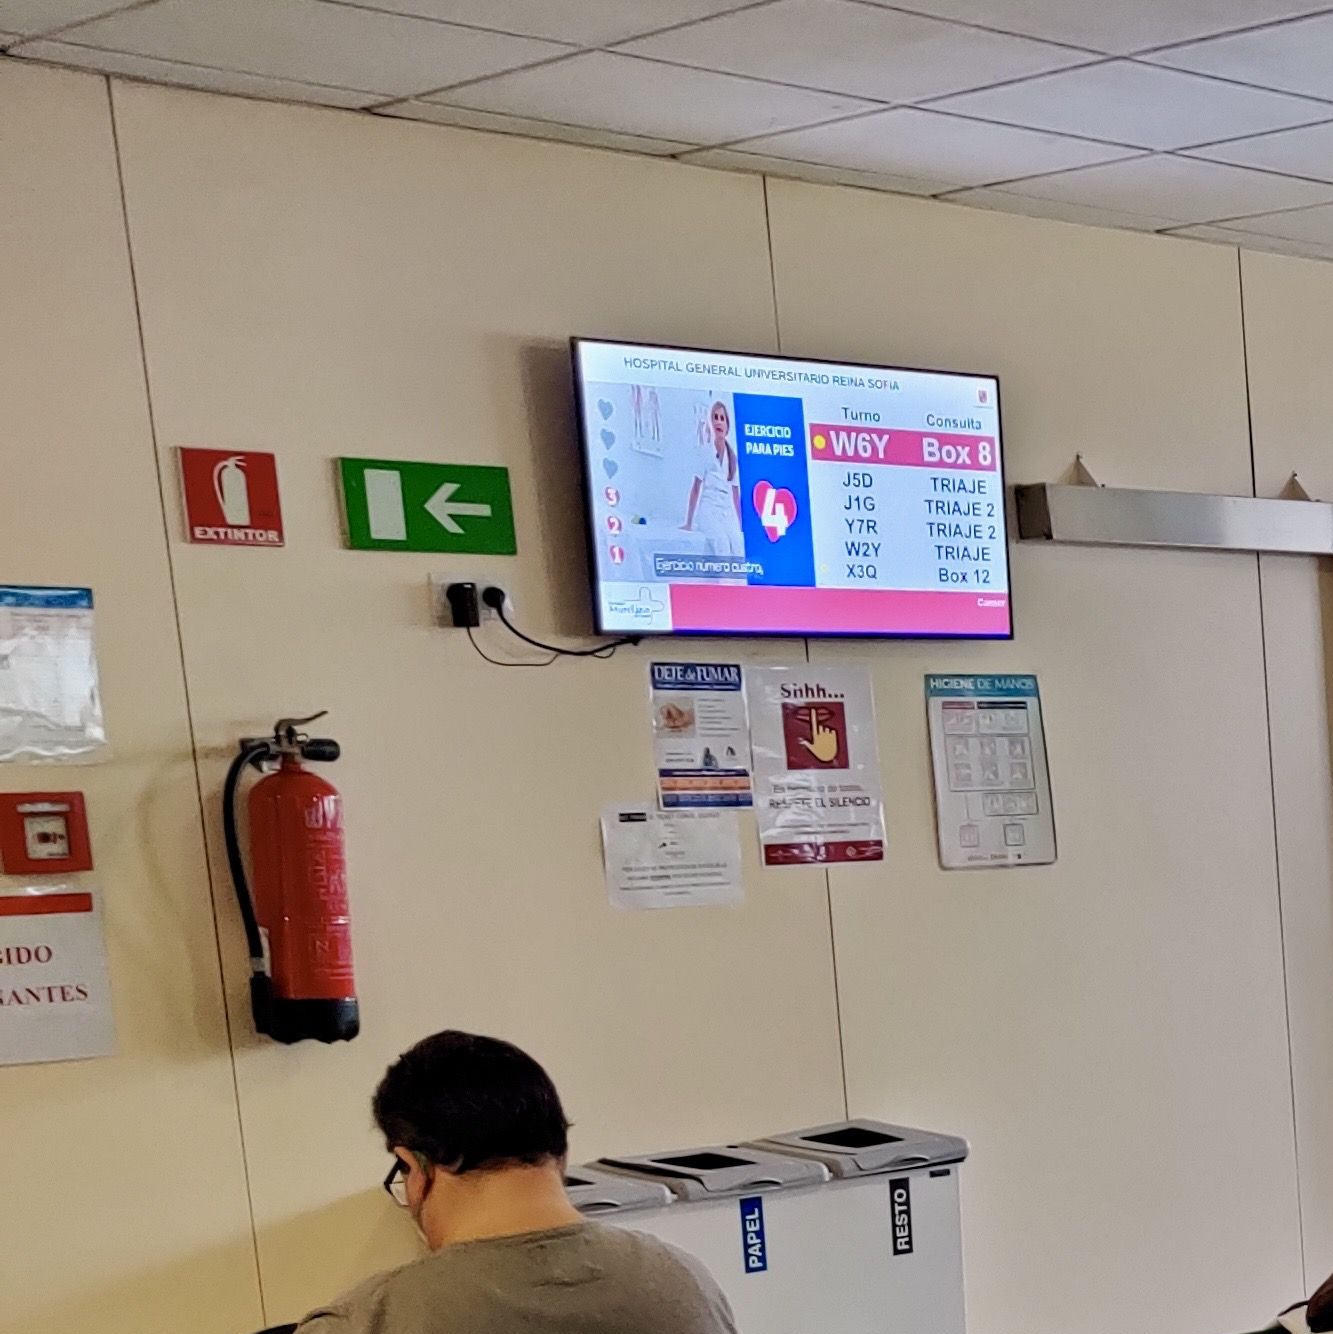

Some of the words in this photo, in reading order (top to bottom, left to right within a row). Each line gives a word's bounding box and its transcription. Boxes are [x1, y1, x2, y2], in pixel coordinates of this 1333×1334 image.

[623, 356, 683, 372] HOSPITAL
[686, 361, 742, 378] GENERAL
[744, 367, 830, 386] UNIVERSITARIO
[832, 375, 865, 389] REINA
[841, 407, 881, 422] Turno
[926, 414, 982, 430] Consulta
[744, 423, 791, 439] EJERCICIO
[745, 442, 772, 456] PARA
[772, 444, 795, 457] PIES
[829, 430, 890, 459] W6Y
[922, 437, 972, 465] Box
[978, 441, 992, 466] 8
[842, 472, 873, 488] J5D
[930, 477, 988, 495] TRIAJE
[761, 488, 789, 536] 4
[843, 495, 876, 512] J1G
[923, 499, 982, 517] TRIAJE
[986, 502, 996, 517] 2
[192, 526, 281, 542] EXTINTOR
[844, 518, 878, 535] Y7R
[925, 522, 984, 540] TRIAJE
[987, 525, 997, 540] 2
[845, 541, 882, 558] W2Y
[934, 545, 992, 562] TRIAJE
[845, 564, 878, 580] X3Q
[938, 568, 969, 584] Box
[972, 569, 991, 584] 12
[696, 666, 739, 681] FUMAR
[930, 678, 975, 690] HIGIENE
[977, 678, 993, 690] DE
[994, 678, 1035, 690] MANOS
[829, 797, 871, 808] SILENCIO
[0, 945, 52, 965] IDO
[894, 1188, 910, 1250] RESTO
[745, 1208, 763, 1269] PAPEL
